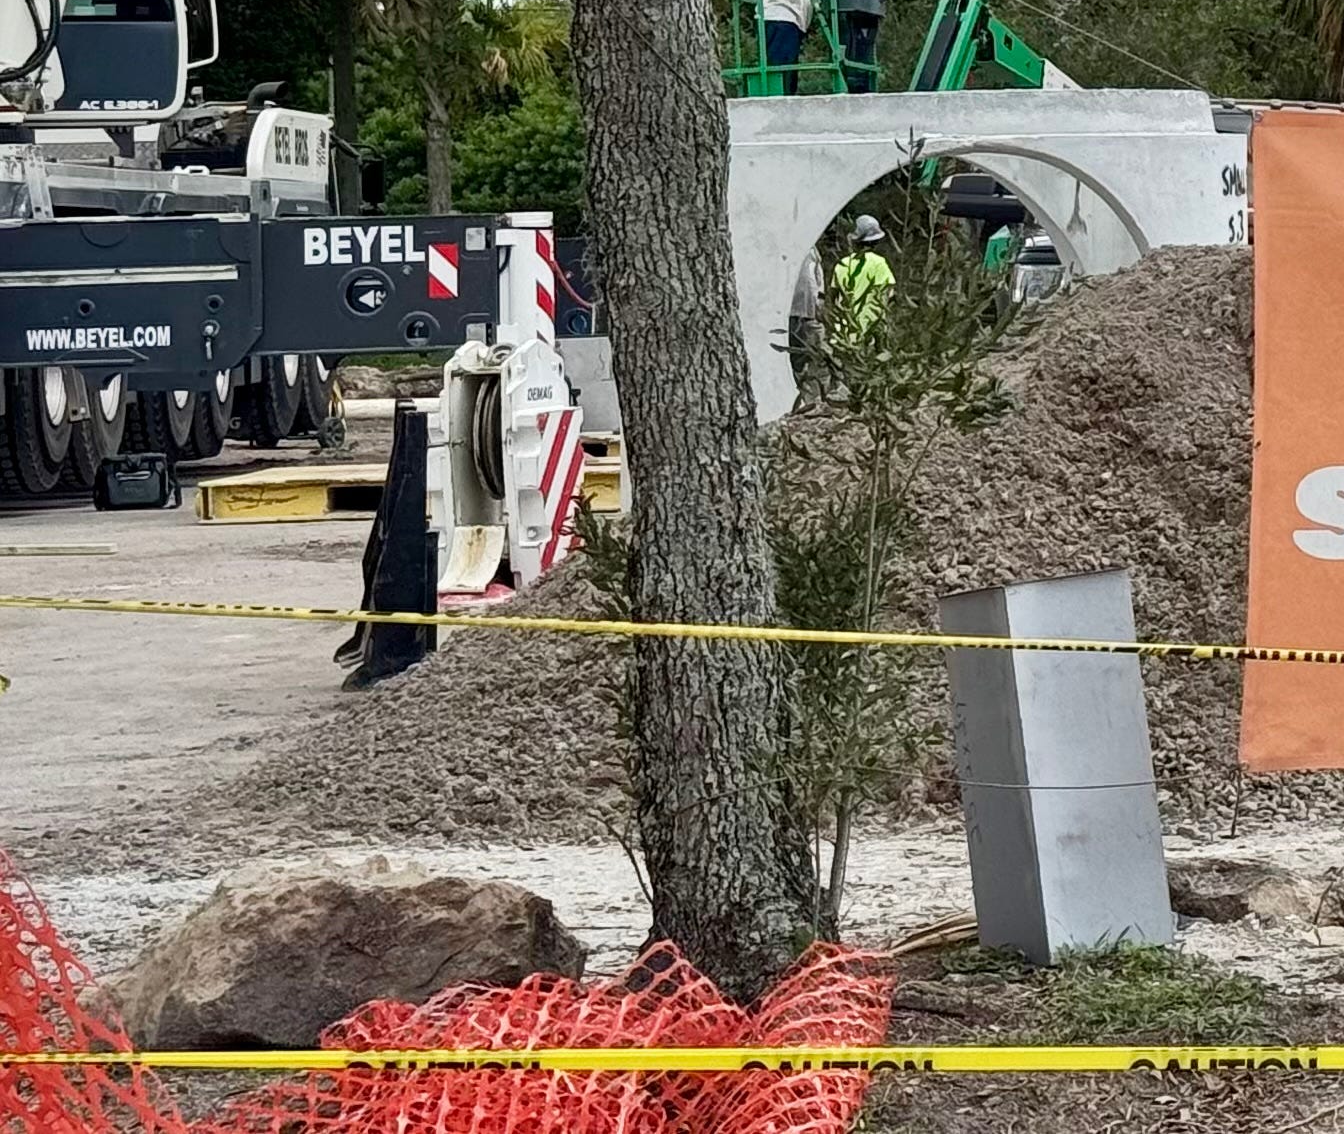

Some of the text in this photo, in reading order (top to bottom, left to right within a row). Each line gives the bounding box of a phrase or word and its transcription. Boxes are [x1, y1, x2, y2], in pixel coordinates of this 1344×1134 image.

[80, 100, 100, 110] AC
[304, 225, 426, 265] BEYEL
[26, 325, 171, 350] WWW.BEYEL.COM
